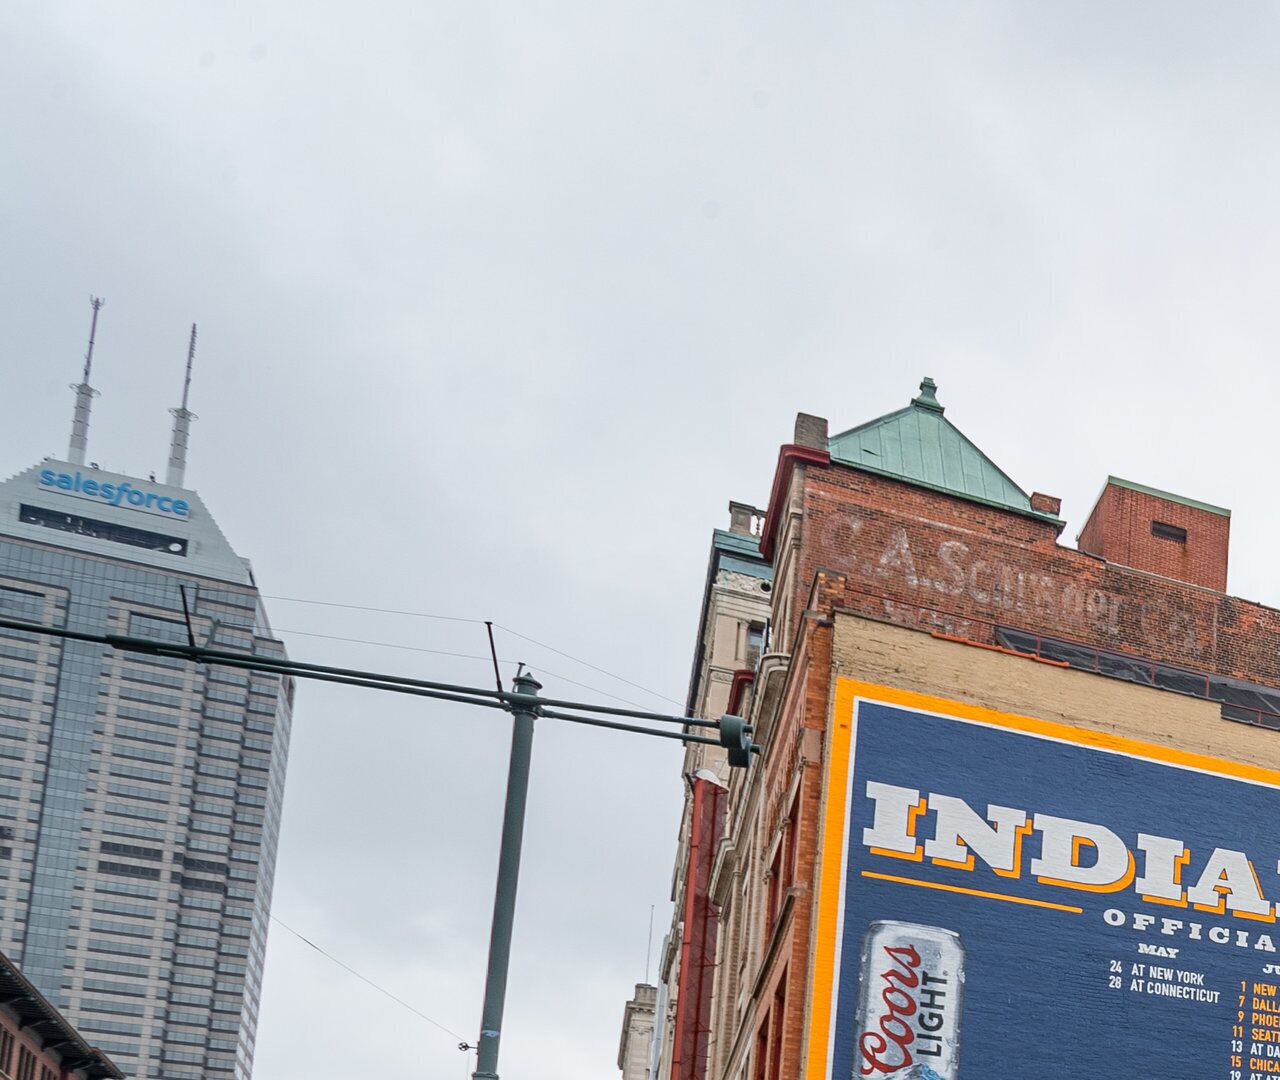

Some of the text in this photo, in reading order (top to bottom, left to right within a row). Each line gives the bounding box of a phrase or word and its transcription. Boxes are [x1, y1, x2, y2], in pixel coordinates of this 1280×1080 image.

[40, 468, 190, 516] salesforce
[1137, 942, 1180, 959] MAY
[1109, 959, 1205, 987] 24 AT NEW YORK
[1108, 975, 1221, 1004] 28 AT CONNECTICUT
[1240, 980, 1247, 993] 1
[1253, 982, 1277, 997] NEW
[858, 943, 922, 1076] Coors
[1238, 995, 1246, 1008] 7
[916, 970, 948, 1058] LIGHT
[1237, 1010, 1245, 1023] 9
[1232, 1024, 1243, 1039] 11
[1231, 1039, 1243, 1053] 13
[1249, 1042, 1265, 1056] AT
[1230, 1054, 1243, 1068] 15
